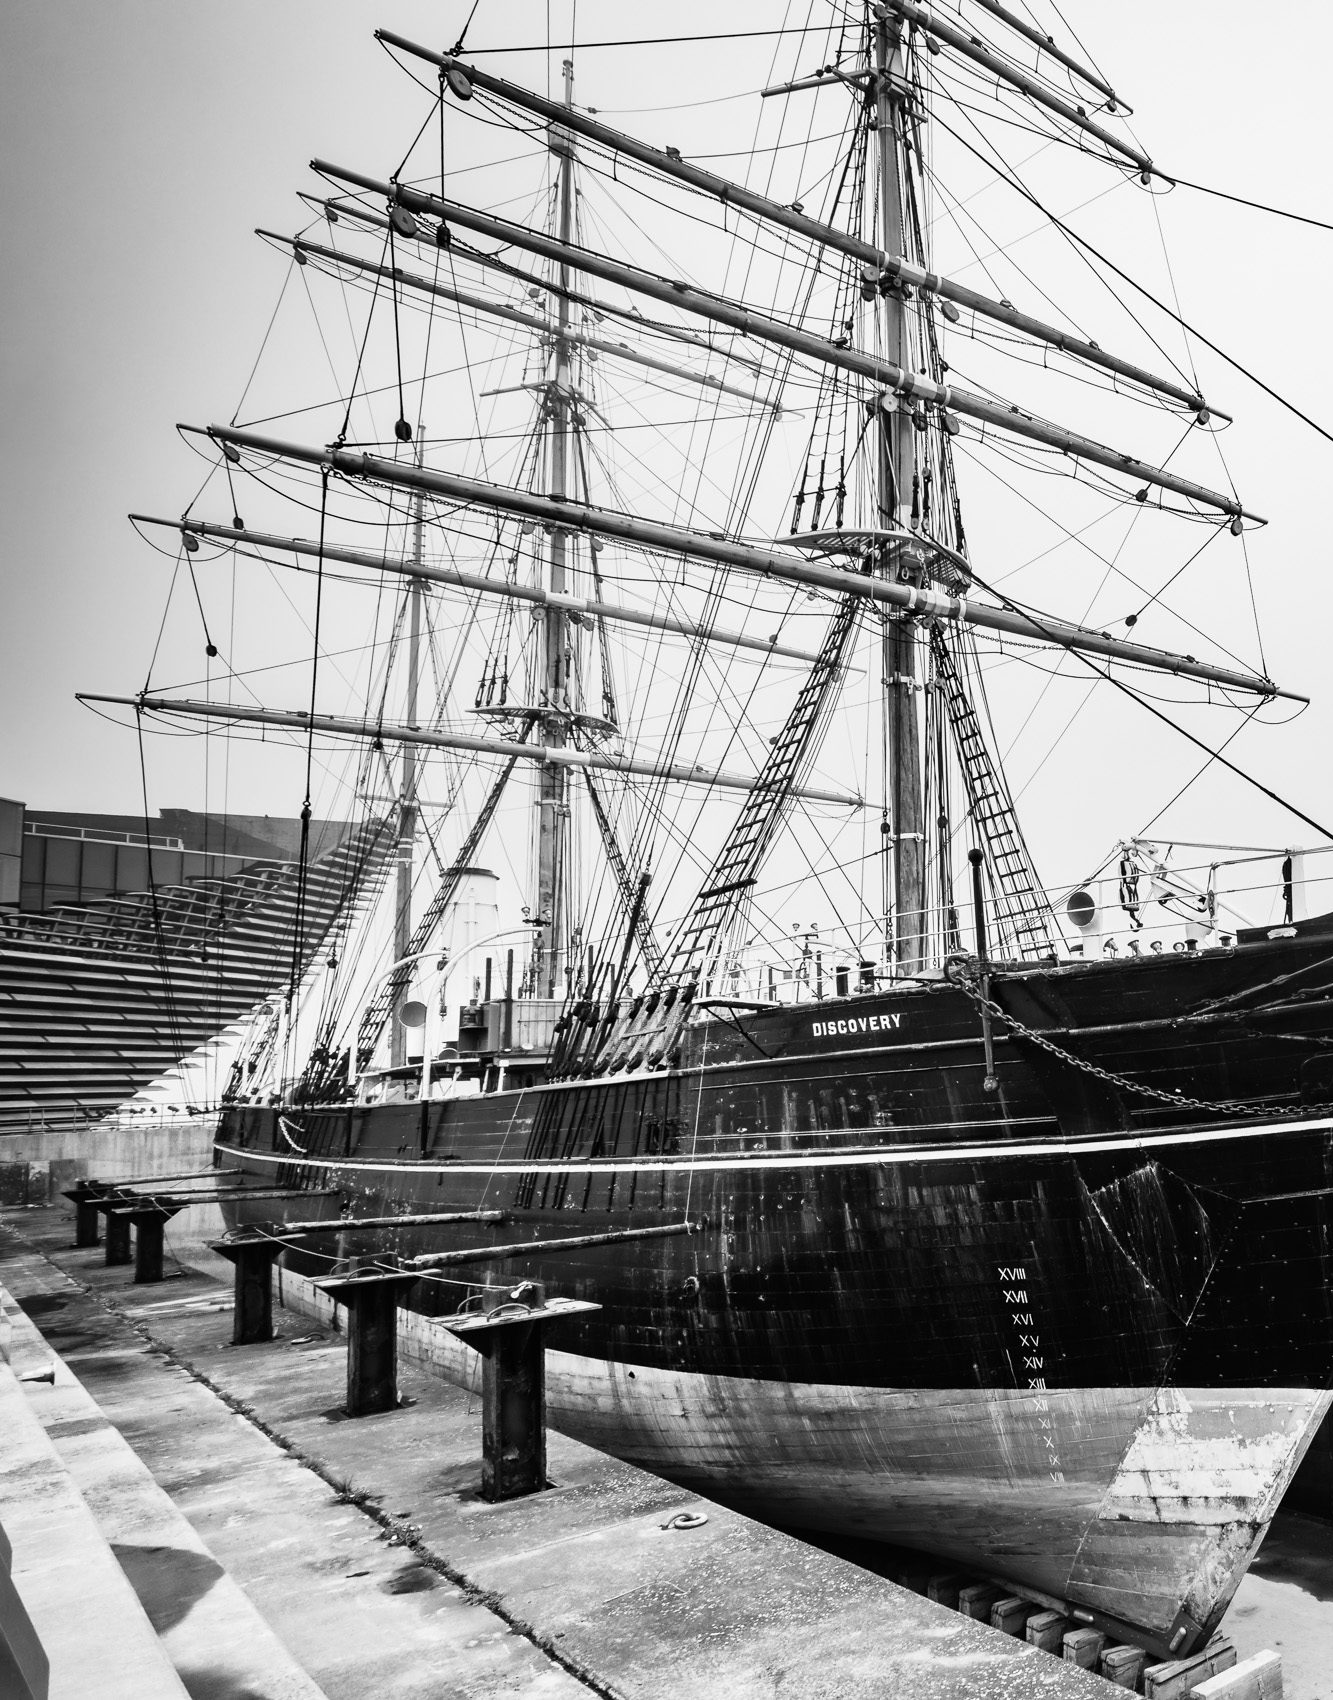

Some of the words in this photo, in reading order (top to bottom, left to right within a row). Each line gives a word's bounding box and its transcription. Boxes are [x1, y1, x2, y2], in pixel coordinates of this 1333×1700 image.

[812, 1014, 901, 1037] DISCOVERY
[998, 1267, 1026, 1281] XVIII
[1002, 1290, 1028, 1304] XVII
[1012, 1313, 1034, 1326] XVI
[1019, 1334, 1039, 1347] XV
[1023, 1356, 1044, 1369] XIV
[1028, 1378, 1046, 1390] XIII
[1033, 1399, 1049, 1412] XII
[1043, 1436, 1055, 1448] X
